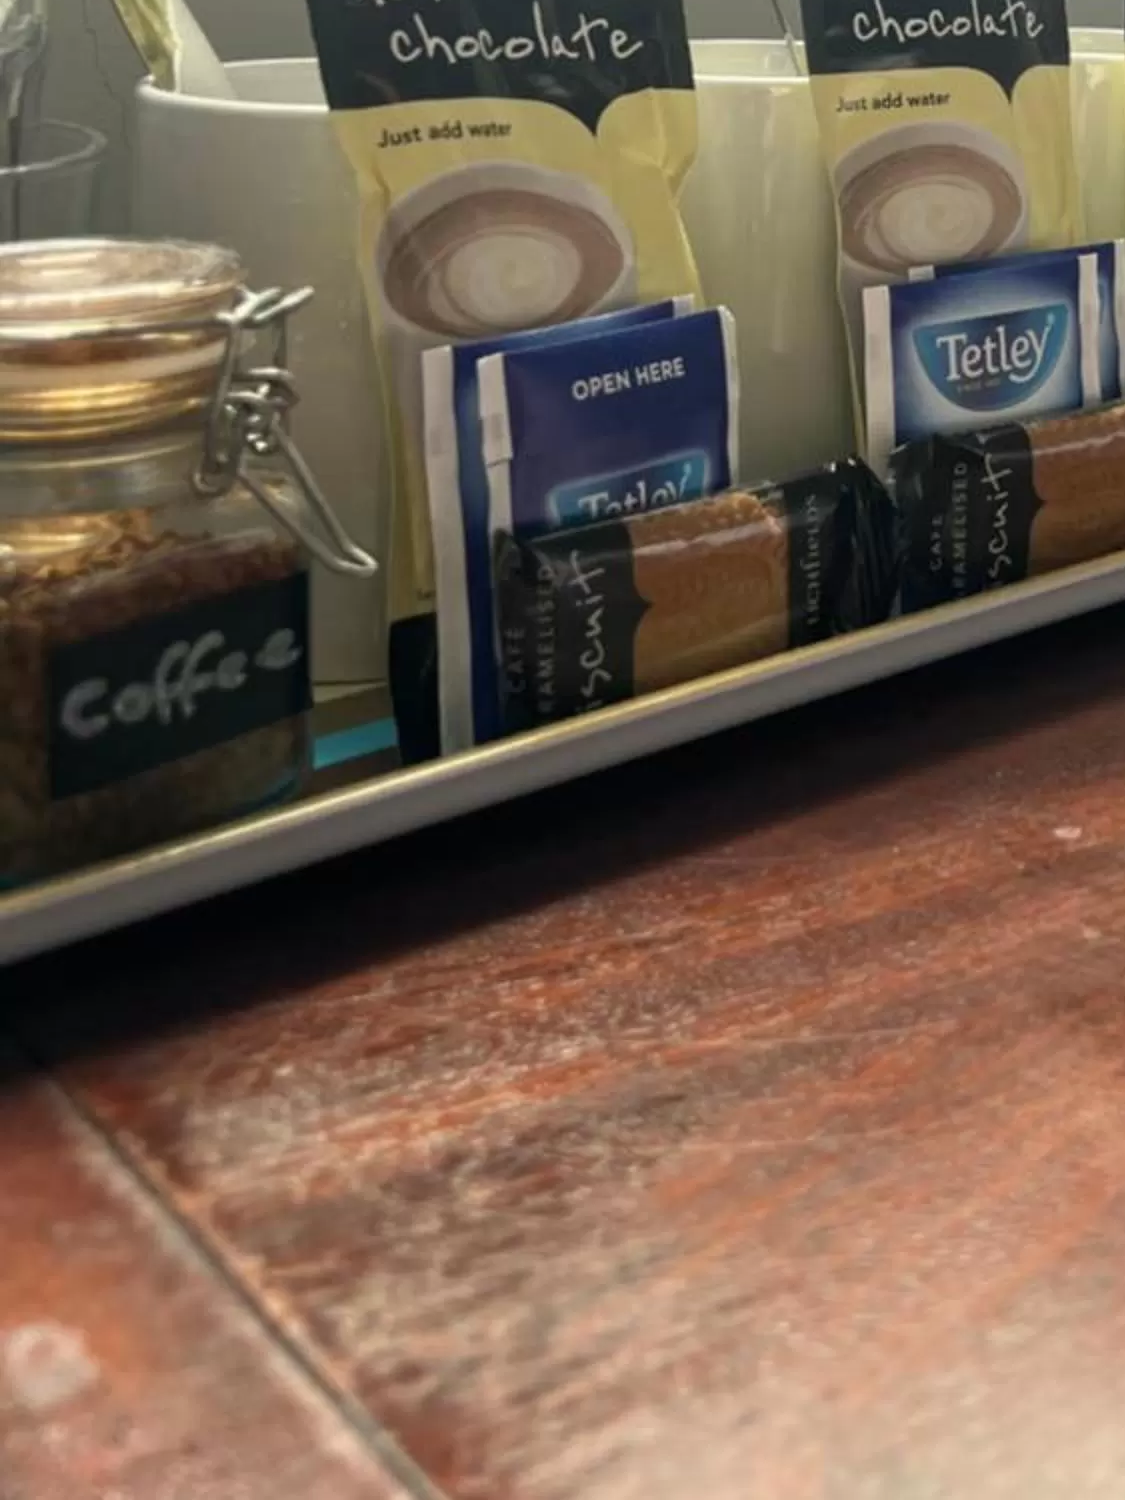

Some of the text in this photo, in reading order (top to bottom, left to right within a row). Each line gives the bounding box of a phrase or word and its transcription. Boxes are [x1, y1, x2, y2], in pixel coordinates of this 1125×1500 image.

[390, 0, 644, 64] chocolate
[836, 92, 950, 113] Just add water
[377, 119, 513, 149] Just add water
[935, 312, 1056, 384] Tetley
[571, 355, 687, 401] OPEN HERE
[61, 627, 302, 739] Coffee
